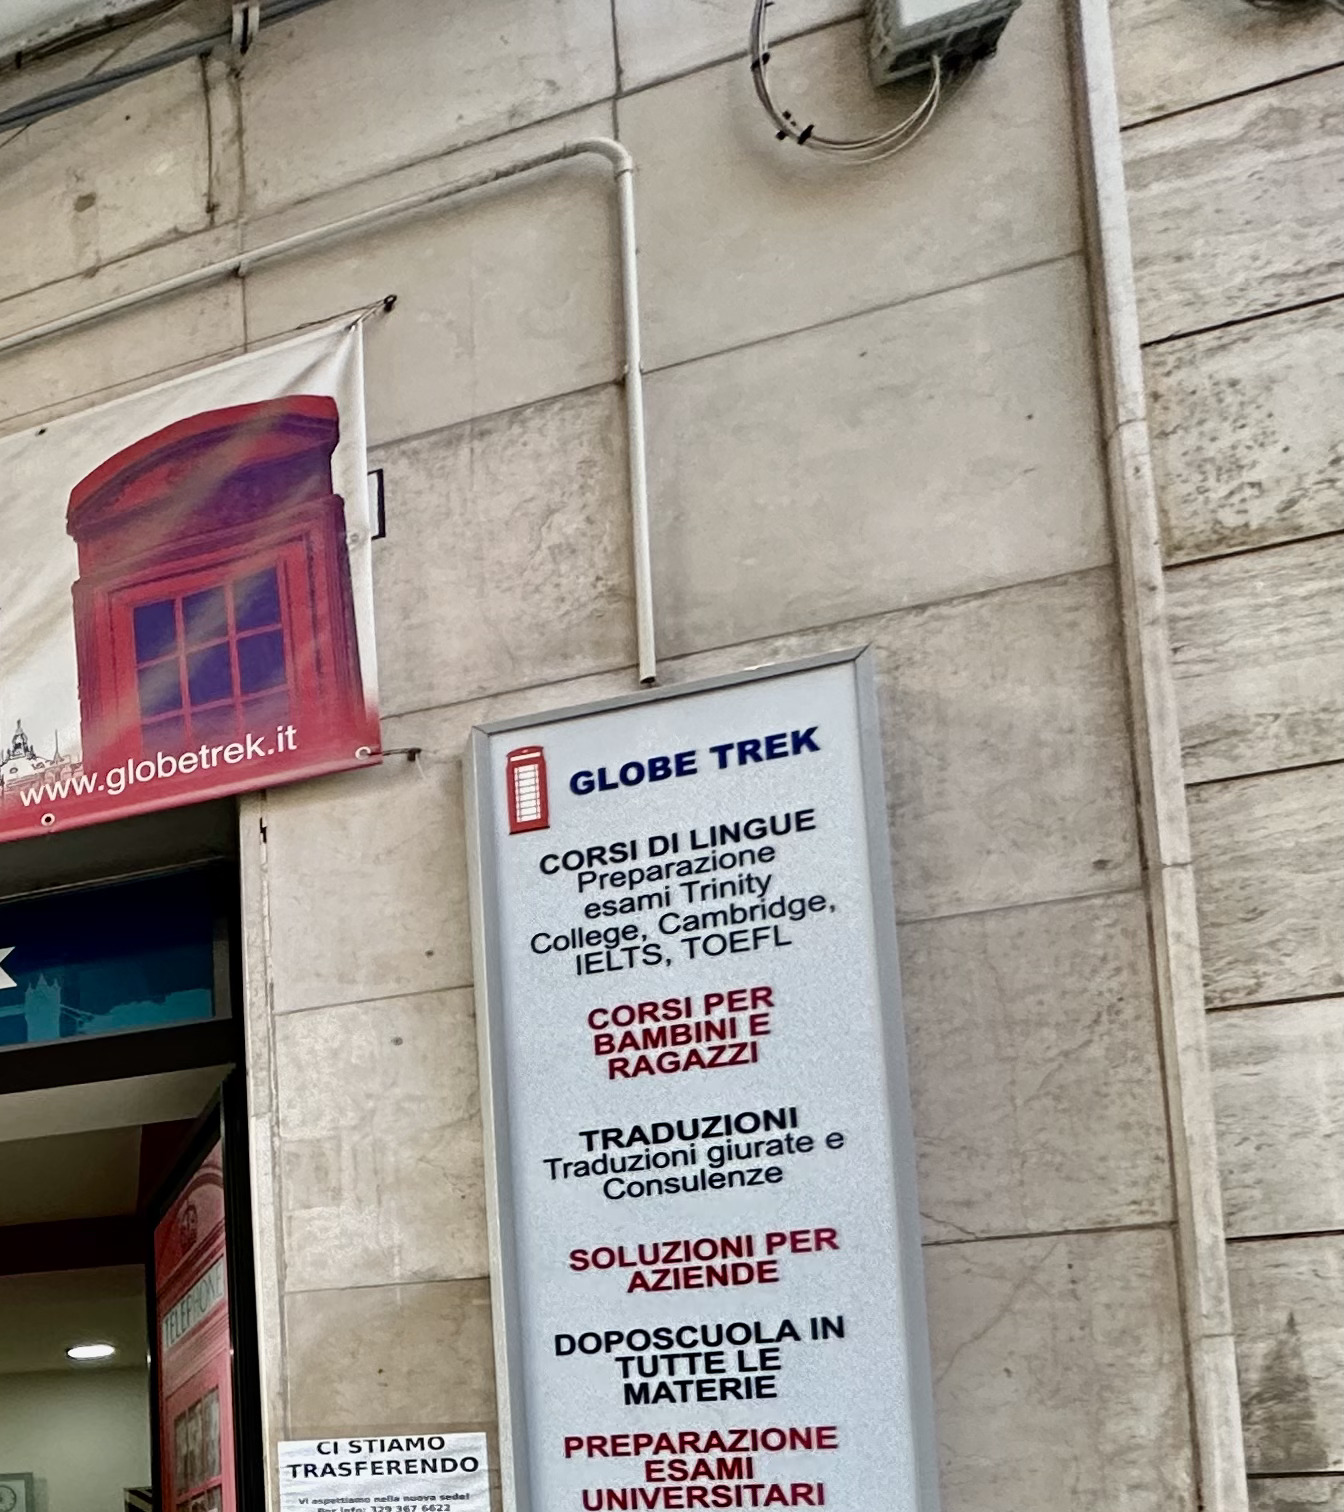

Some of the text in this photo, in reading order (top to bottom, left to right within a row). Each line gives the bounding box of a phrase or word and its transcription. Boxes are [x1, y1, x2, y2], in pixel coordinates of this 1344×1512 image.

[20, 725, 298, 808] www.globetrek.it
[569, 726, 821, 796] GLOBE TREK
[540, 808, 816, 875] CORSI DI LINGUE
[577, 843, 776, 894] Preparazione
[584, 871, 772, 920] esami Trinity
[531, 891, 836, 955] College, Cambridge,
[575, 925, 792, 977] IELTS, TOEFL
[587, 985, 774, 1031] CORSI PER
[594, 1013, 771, 1056] BAMBINI E
[608, 1041, 758, 1079] RAGAZZI
[580, 1107, 797, 1152] TRADUZIONI
[545, 1130, 844, 1181] Traduzioni giurate e
[603, 1164, 783, 1201] Consulenze
[569, 1228, 839, 1272] SOLUZIONI PER
[627, 1260, 779, 1294] AZIENDE
[164, 1263, 224, 1347] TELEPHONE
[554, 1316, 844, 1356] DOPOSCUOLA IN
[617, 1347, 781, 1379] TUTTE LE
[623, 1375, 777, 1405] MATERIE
[317, 1436, 445, 1455] CI STIAMO
[564, 1426, 838, 1458] PREPARAZIONE
[287, 1456, 480, 1479] TRASFERENDO
[645, 1457, 753, 1483] ESAMI
[312, 1497, 370, 1505] aspettiamo
[403, 1494, 436, 1502] nuova
[396, 1505, 417, 1512] 367
[421, 1504, 450, 1512] 6622
[582, 1483, 825, 1511] UNIVERSITARI
